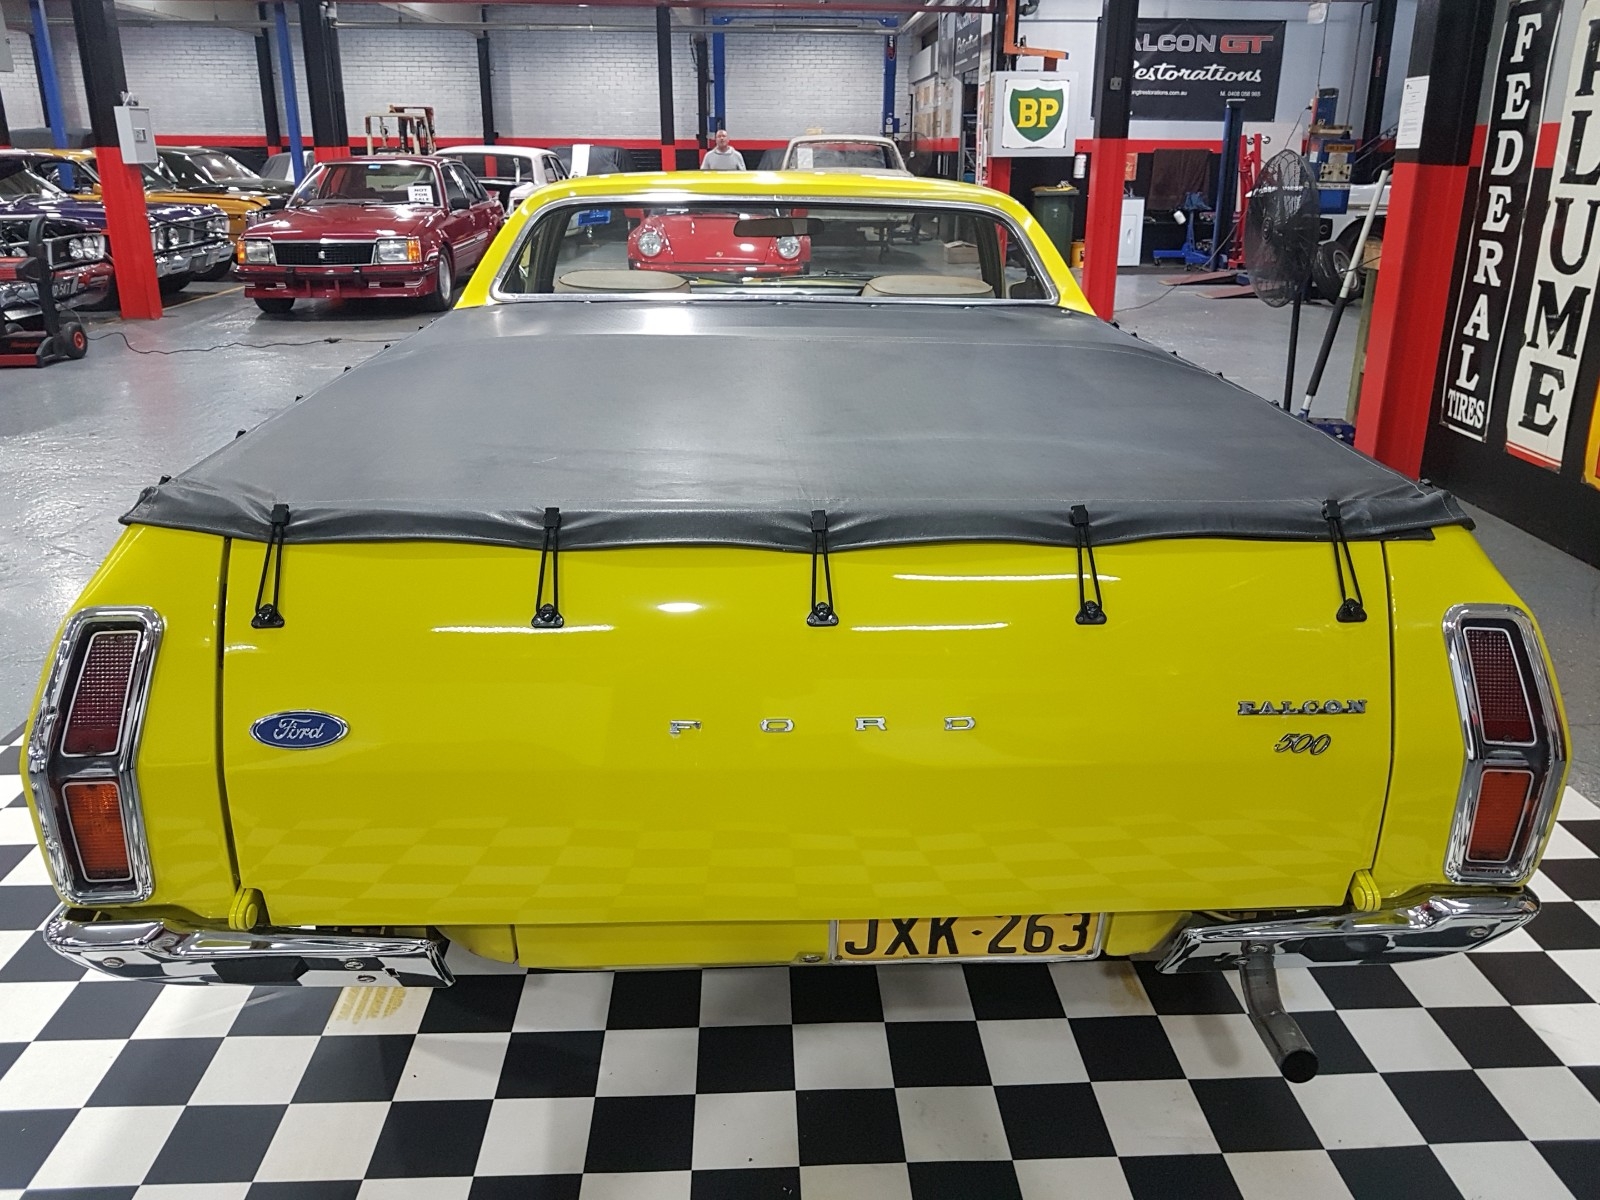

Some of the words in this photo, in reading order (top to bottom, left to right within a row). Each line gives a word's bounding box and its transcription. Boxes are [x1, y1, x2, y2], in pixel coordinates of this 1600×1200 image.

[1135, 33, 1217, 52] LCON
[1220, 34, 1274, 53] GT
[1016, 98, 1060, 128] BP
[1456, 13, 1542, 392] FEDERAL
[1447, 388, 1486, 429] TIRES
[1238, 699, 1368, 716] FALCON
[273, 718, 326, 740] Ford
[669, 716, 977, 735] FORD
[1273, 733, 1332, 756] 500
